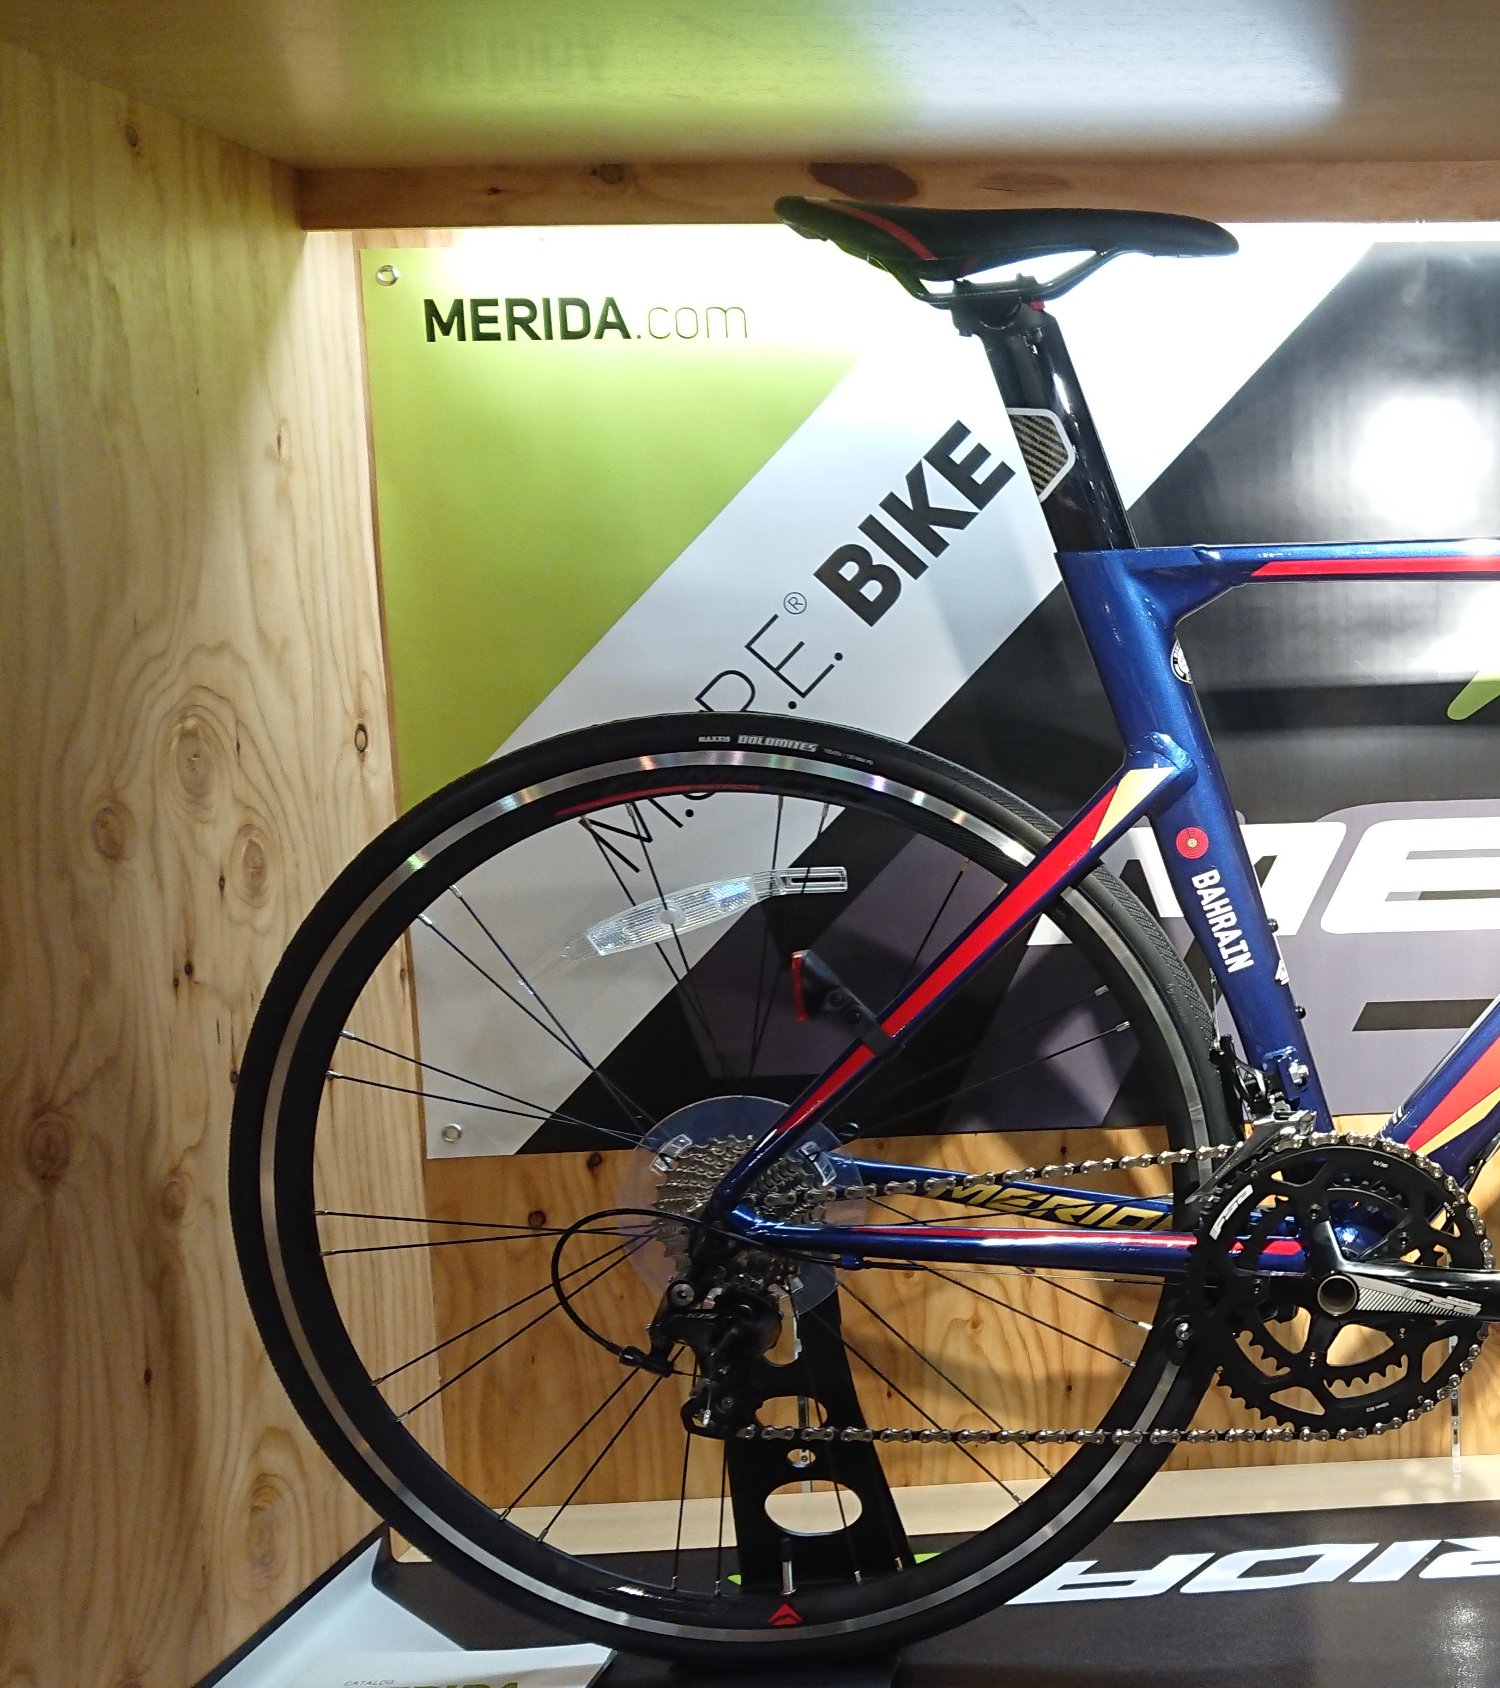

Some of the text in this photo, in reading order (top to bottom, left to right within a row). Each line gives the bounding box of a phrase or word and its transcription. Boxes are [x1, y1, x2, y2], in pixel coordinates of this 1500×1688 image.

[424, 296, 748, 343] MERIDA.com
[813, 420, 1016, 628] BIKE
[737, 735, 819, 752] DOLOMITES
[1191, 869, 1255, 973] BAHRAIN
